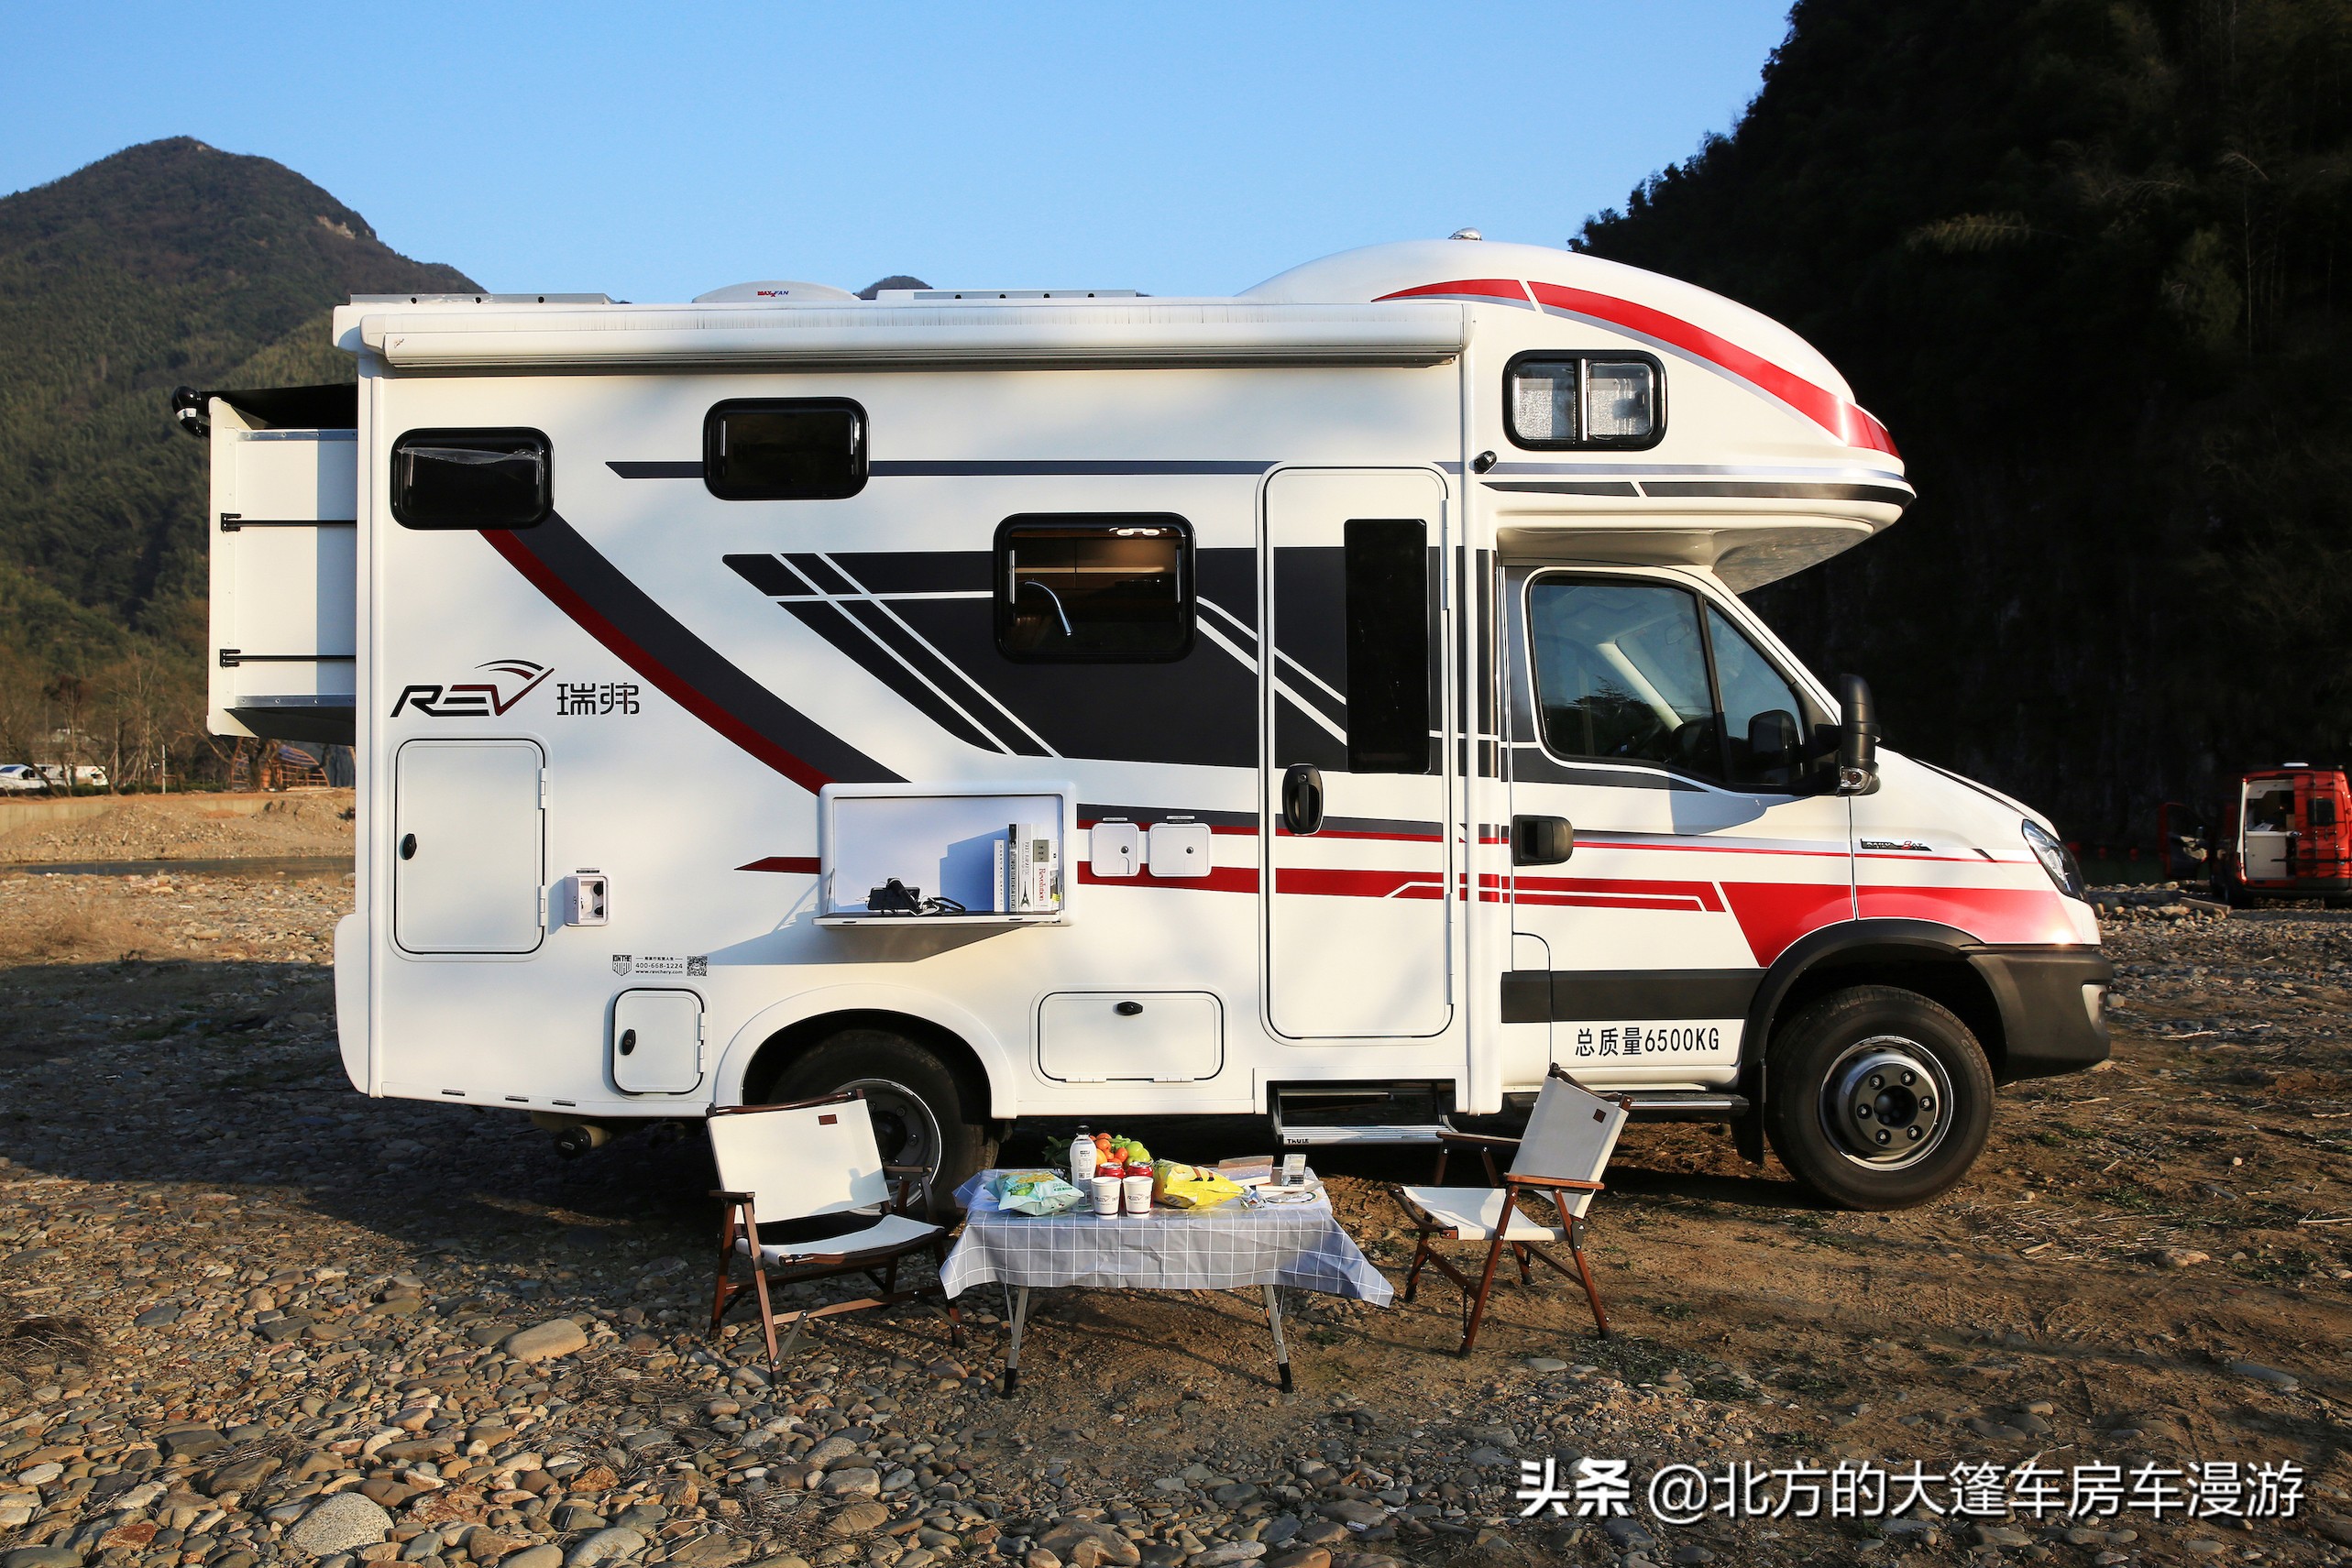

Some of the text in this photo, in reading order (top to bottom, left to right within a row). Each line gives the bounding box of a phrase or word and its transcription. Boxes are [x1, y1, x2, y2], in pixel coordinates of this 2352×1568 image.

[390, 666, 555, 718] REV
[555, 681, 641, 717] 瑞弗
[1574, 1026, 1720, 1058] 总质量6500KG
